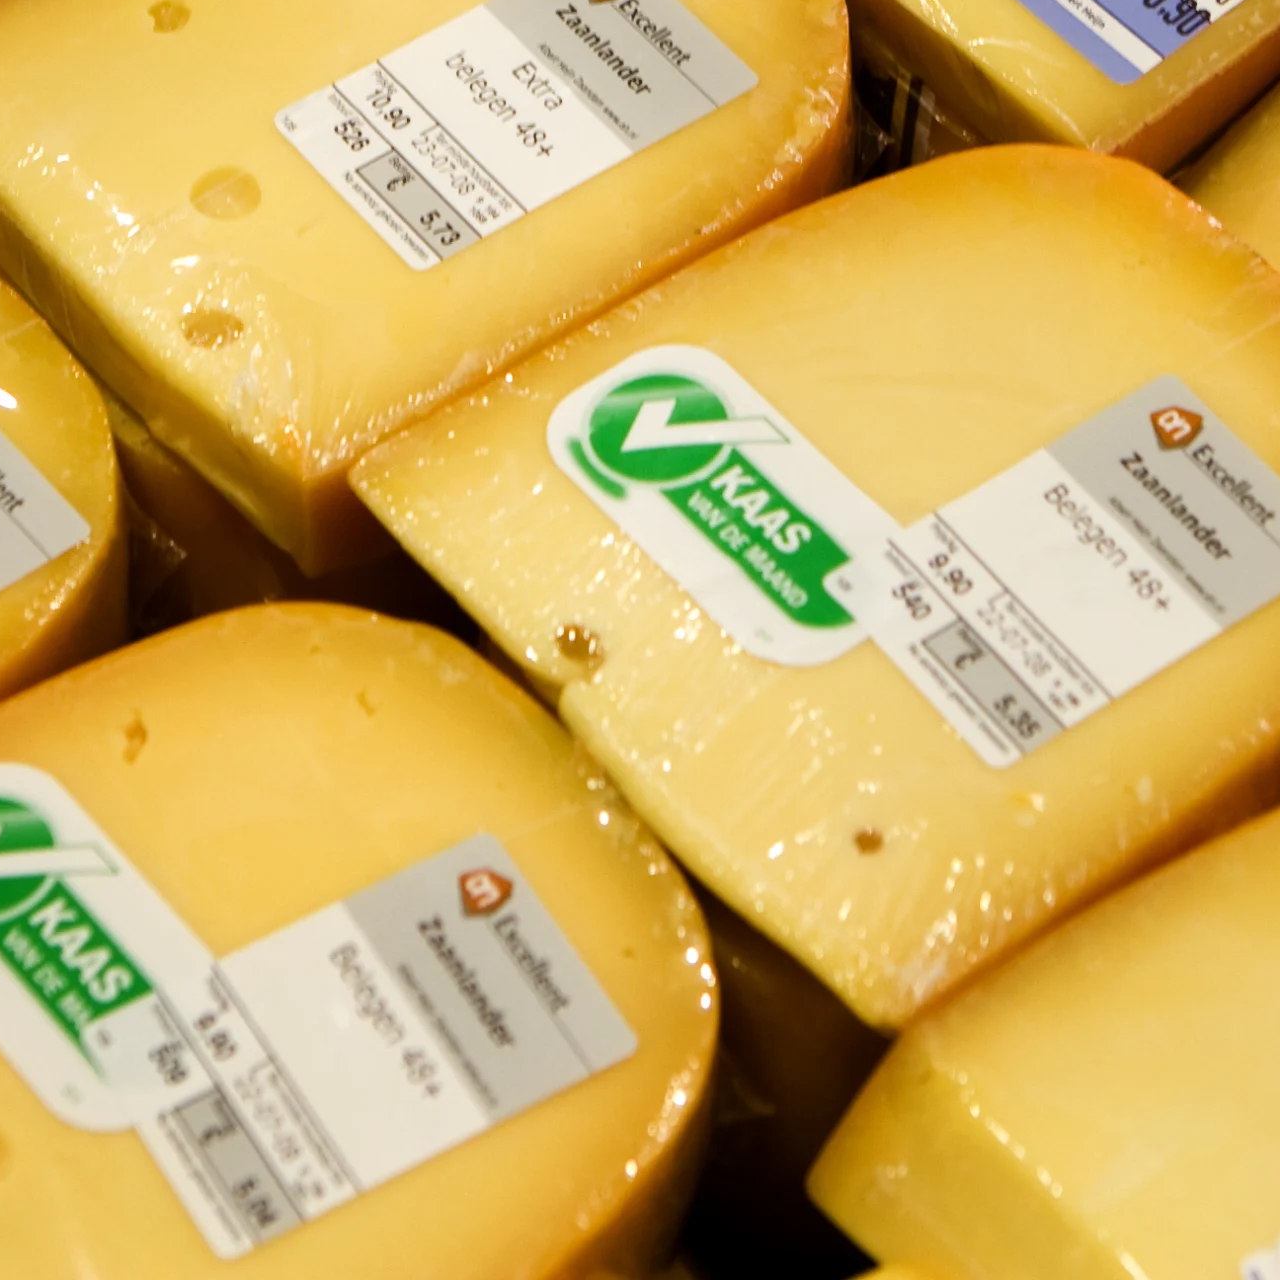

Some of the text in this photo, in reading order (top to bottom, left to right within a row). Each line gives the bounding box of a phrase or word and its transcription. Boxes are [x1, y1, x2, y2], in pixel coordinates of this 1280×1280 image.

[509, 60, 568, 112] Extra
[552, 2, 656, 97] Zaanlander
[331, 118, 373, 152] 526
[364, 87, 414, 131] 10,90
[441, 51, 522, 123] belegen
[512, 119, 558, 159] 48+
[416, 208, 464, 248] 5,73
[708, 458, 814, 567] KAAS
[1118, 448, 1235, 564] Zaanlander
[1190, 441, 1277, 527] Excellent
[683, 484, 810, 611] VAN DE MAAND
[925, 551, 975, 597] 9,90
[1040, 480, 1174, 613] Belegen 48+
[0, 922, 66, 1000] VAN DE
[26, 891, 132, 1010] KAAS
[322, 942, 414, 1048] Belegen
[411, 913, 523, 1047] Zaanlander
[489, 913, 574, 1016] Excellent
